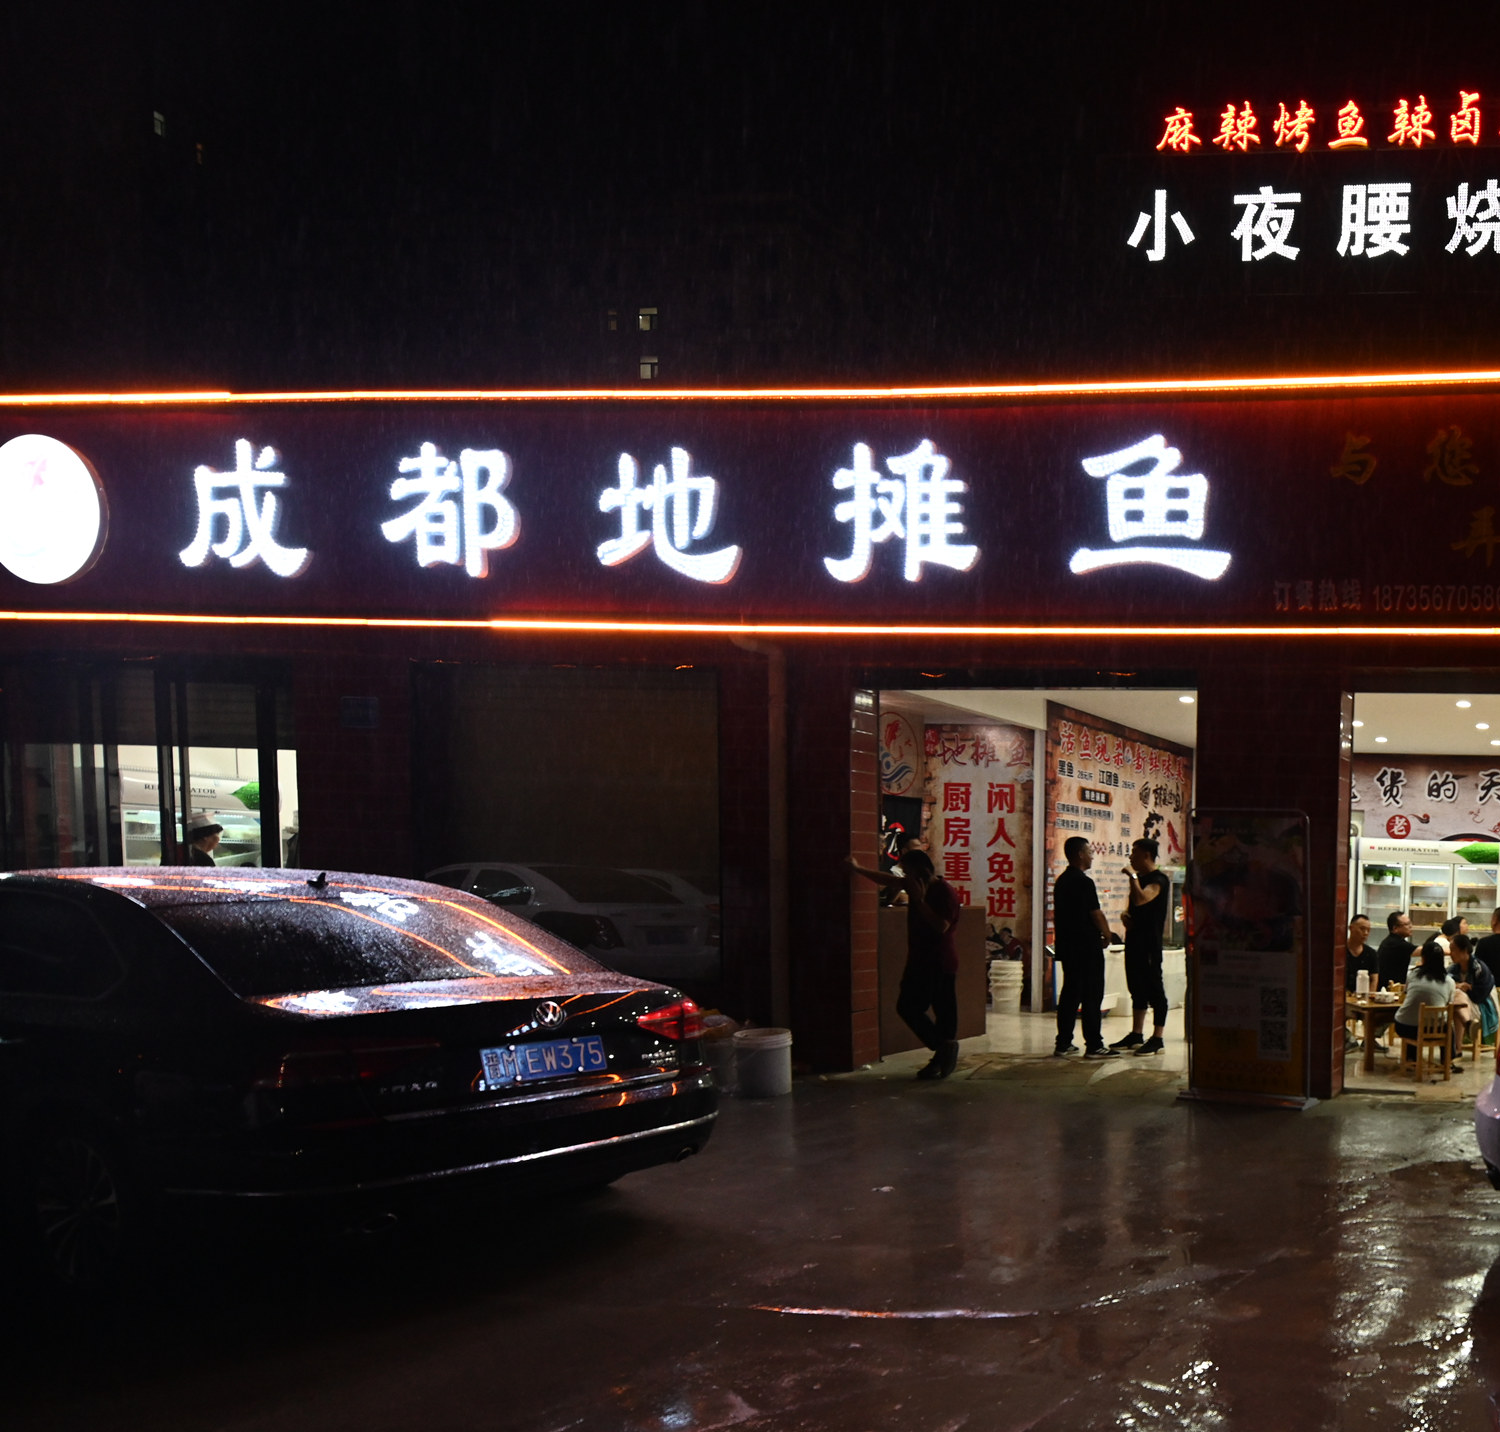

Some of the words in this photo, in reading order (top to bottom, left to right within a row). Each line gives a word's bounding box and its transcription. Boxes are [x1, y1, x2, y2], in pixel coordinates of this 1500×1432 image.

[179, 431, 1233, 585] 成都地摊鱼
[937, 733, 1031, 768] 地摊鱼
[942, 781, 972, 906] 厨房重
[987, 781, 1016, 918] 闲人免进
[1389, 816, 1410, 837] 老
